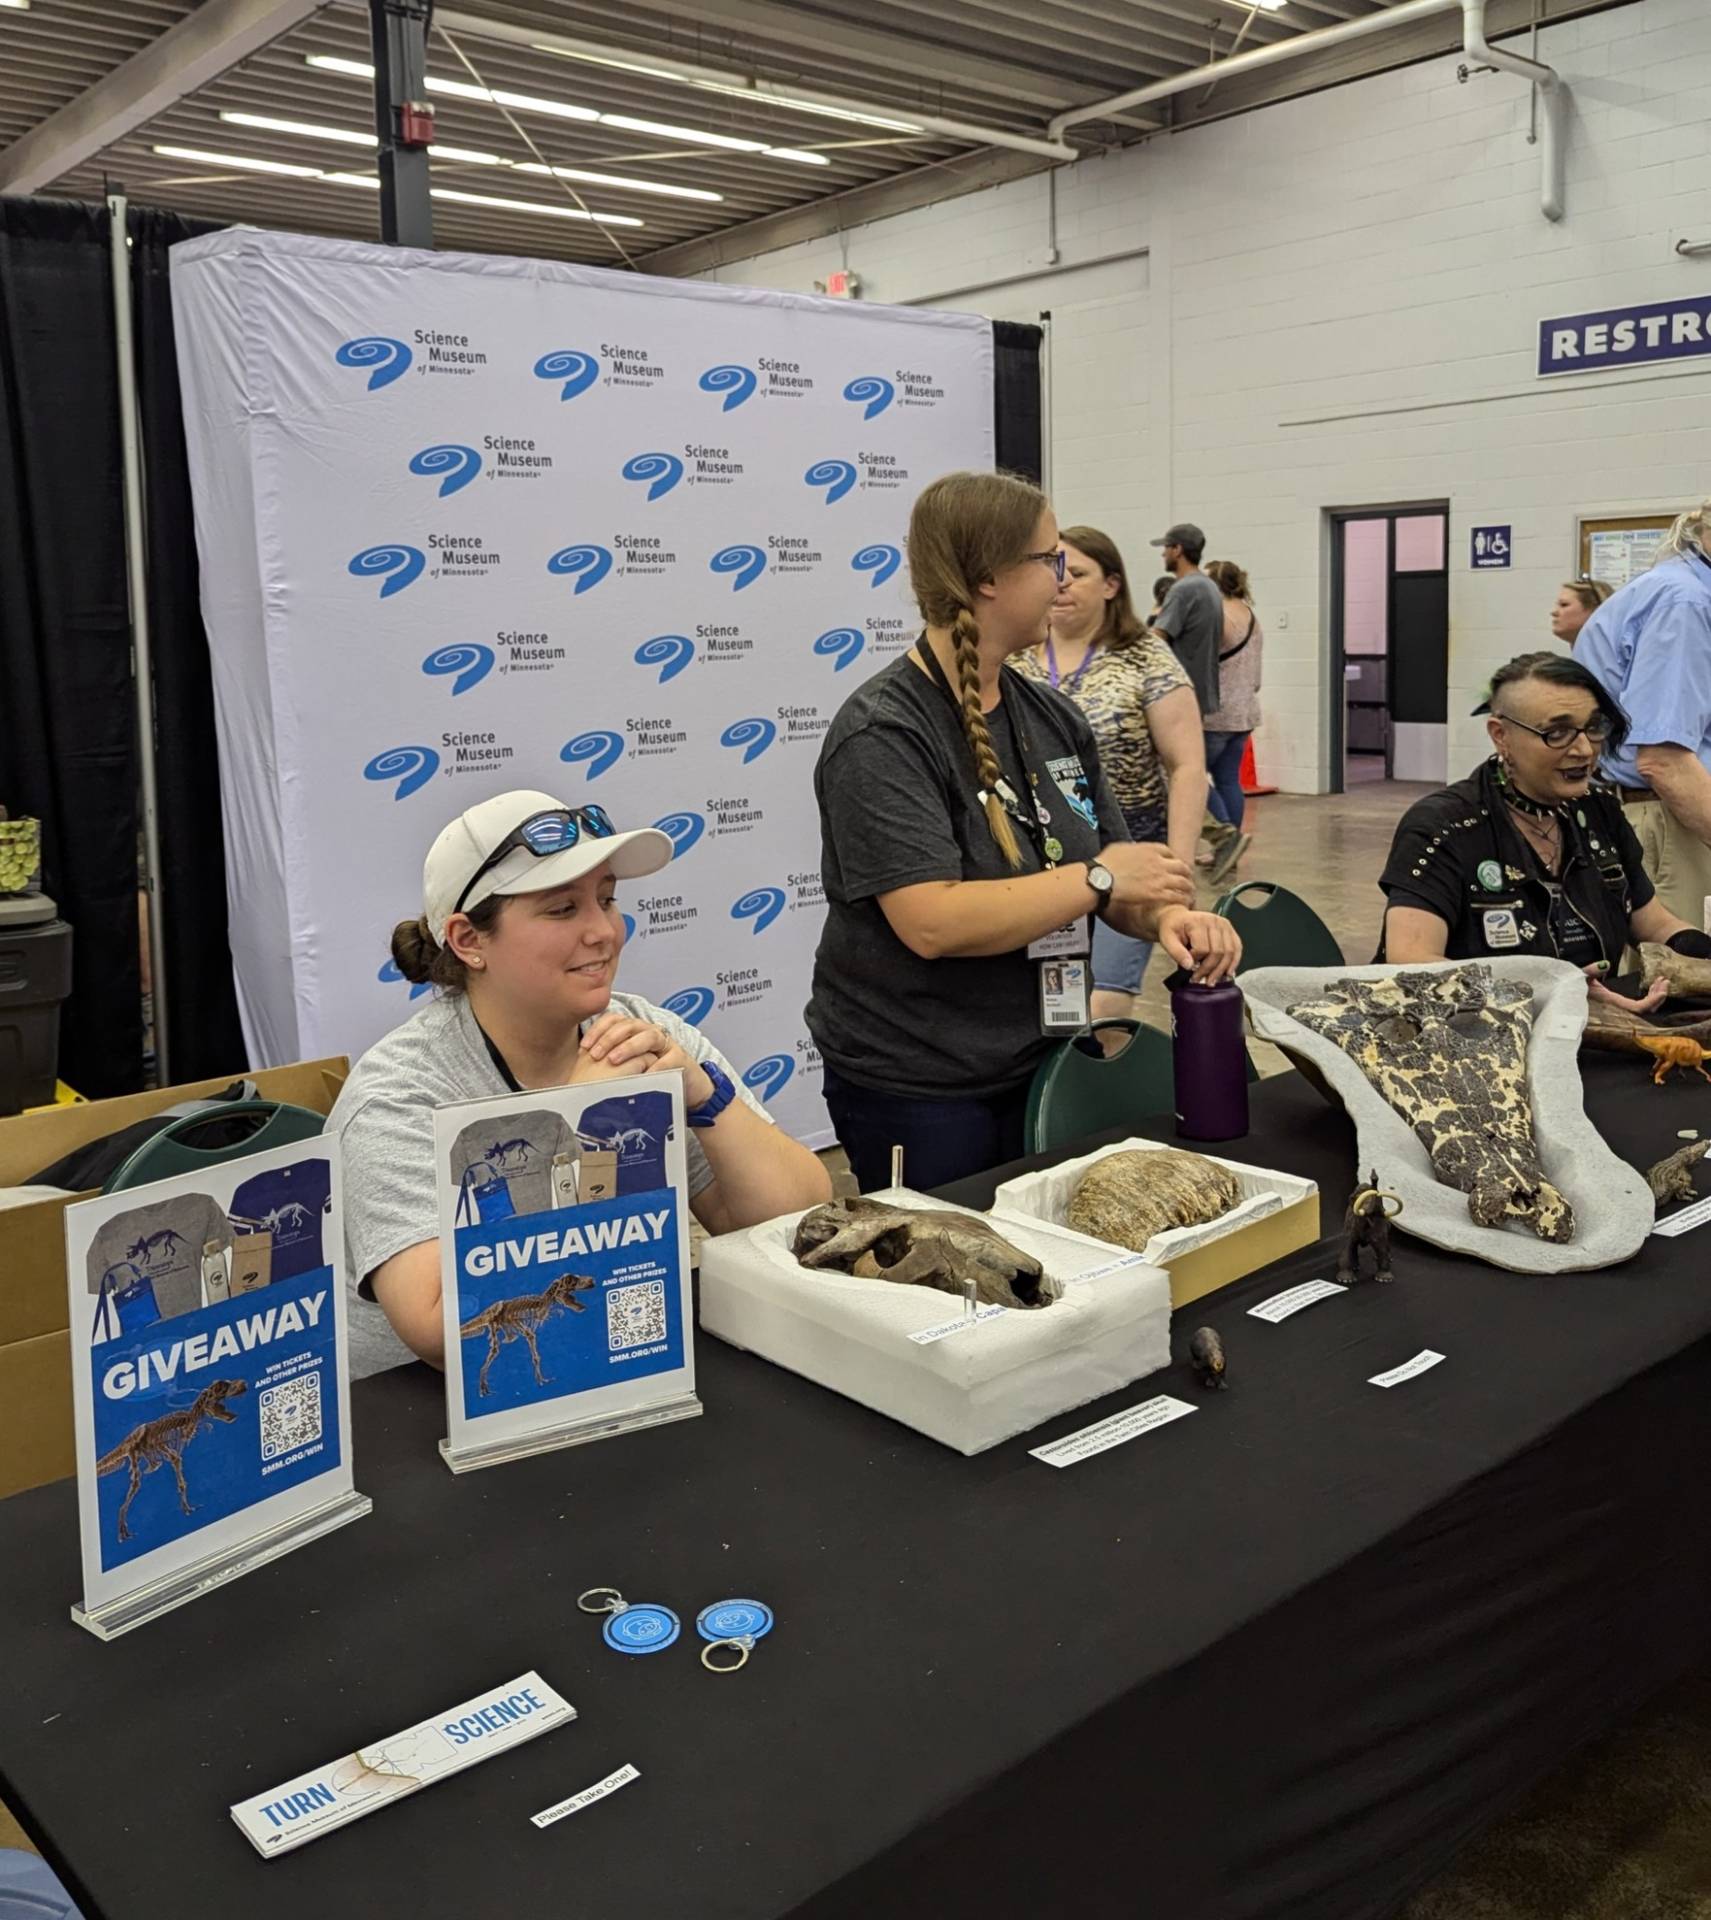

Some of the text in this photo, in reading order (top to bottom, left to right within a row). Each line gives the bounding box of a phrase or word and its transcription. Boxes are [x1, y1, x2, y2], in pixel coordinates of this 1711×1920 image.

[414, 330, 468, 347] Science
[1552, 311, 1711, 360] RESTR
[429, 347, 487, 364] Museum
[600, 344, 648, 362] Science
[417, 365, 427, 376] of
[613, 361, 664, 378] Museum
[758, 358, 800, 374] Science
[604, 377, 612, 387] of
[769, 373, 813, 389] Museum
[896, 370, 932, 386] Science
[760, 388, 768, 398] of
[905, 384, 944, 399] Museum
[484, 436, 535, 451] Science
[498, 452, 552, 468] Museum
[686, 445, 728, 460] Science
[858, 452, 896, 466] Science
[486, 469, 496, 480] of
[696, 460, 744, 474] Museum
[868, 466, 908, 480] Museum
[688, 475, 696, 486] of
[428, 534, 482, 549] Science
[614, 535, 660, 549] Science
[768, 536, 808, 549] Science
[442, 550, 500, 565] Museum
[626, 550, 676, 564] Museum
[778, 550, 822, 563] Museum
[430, 567, 440, 578] of
[617, 566, 626, 576] of
[770, 565, 778, 574] of
[696, 624, 740, 638] Science
[866, 617, 904, 630] Science
[497, 632, 548, 646] Science
[707, 638, 753, 652] Museum
[510, 646, 566, 660] Museum
[698, 654, 706, 664] of
[500, 663, 508, 674] of
[778, 706, 818, 719] Science
[626, 718, 672, 732] Science
[788, 718, 830, 732] Museum
[442, 732, 496, 748] Science
[638, 731, 687, 746] Museum
[456, 746, 514, 762] Museum
[628, 749, 636, 760] of
[444, 765, 454, 777] of
[706, 797, 748, 812] Science
[717, 809, 763, 825] Museum
[708, 828, 716, 839] of
[788, 872, 821, 886] Scienc
[798, 886, 824, 898] Muse
[638, 896, 683, 912] Science
[649, 907, 698, 924] Museum
[640, 929, 648, 940] of
[716, 967, 758, 985] Science
[727, 979, 772, 998] Museum
[718, 1002, 726, 1011] of
[465, 1209, 670, 1277] GIVEAWAY
[612, 1260, 656, 1276] WIN TICKETS
[602, 1267, 667, 1286] AND OTHER PRIZES
[103, 1290, 327, 1400] GIVEAWAY
[609, 1344, 668, 1364] SMM.ORG/WIN
[266, 1352, 312, 1375] WIN TICKETS
[254, 1356, 323, 1388] AND OTHER PRIZES
[262, 1443, 324, 1476] SMM.ORG/WIN
[258, 1688, 546, 1827] TURN SCIENCE
[536, 1768, 632, 1825] Please Take One!
